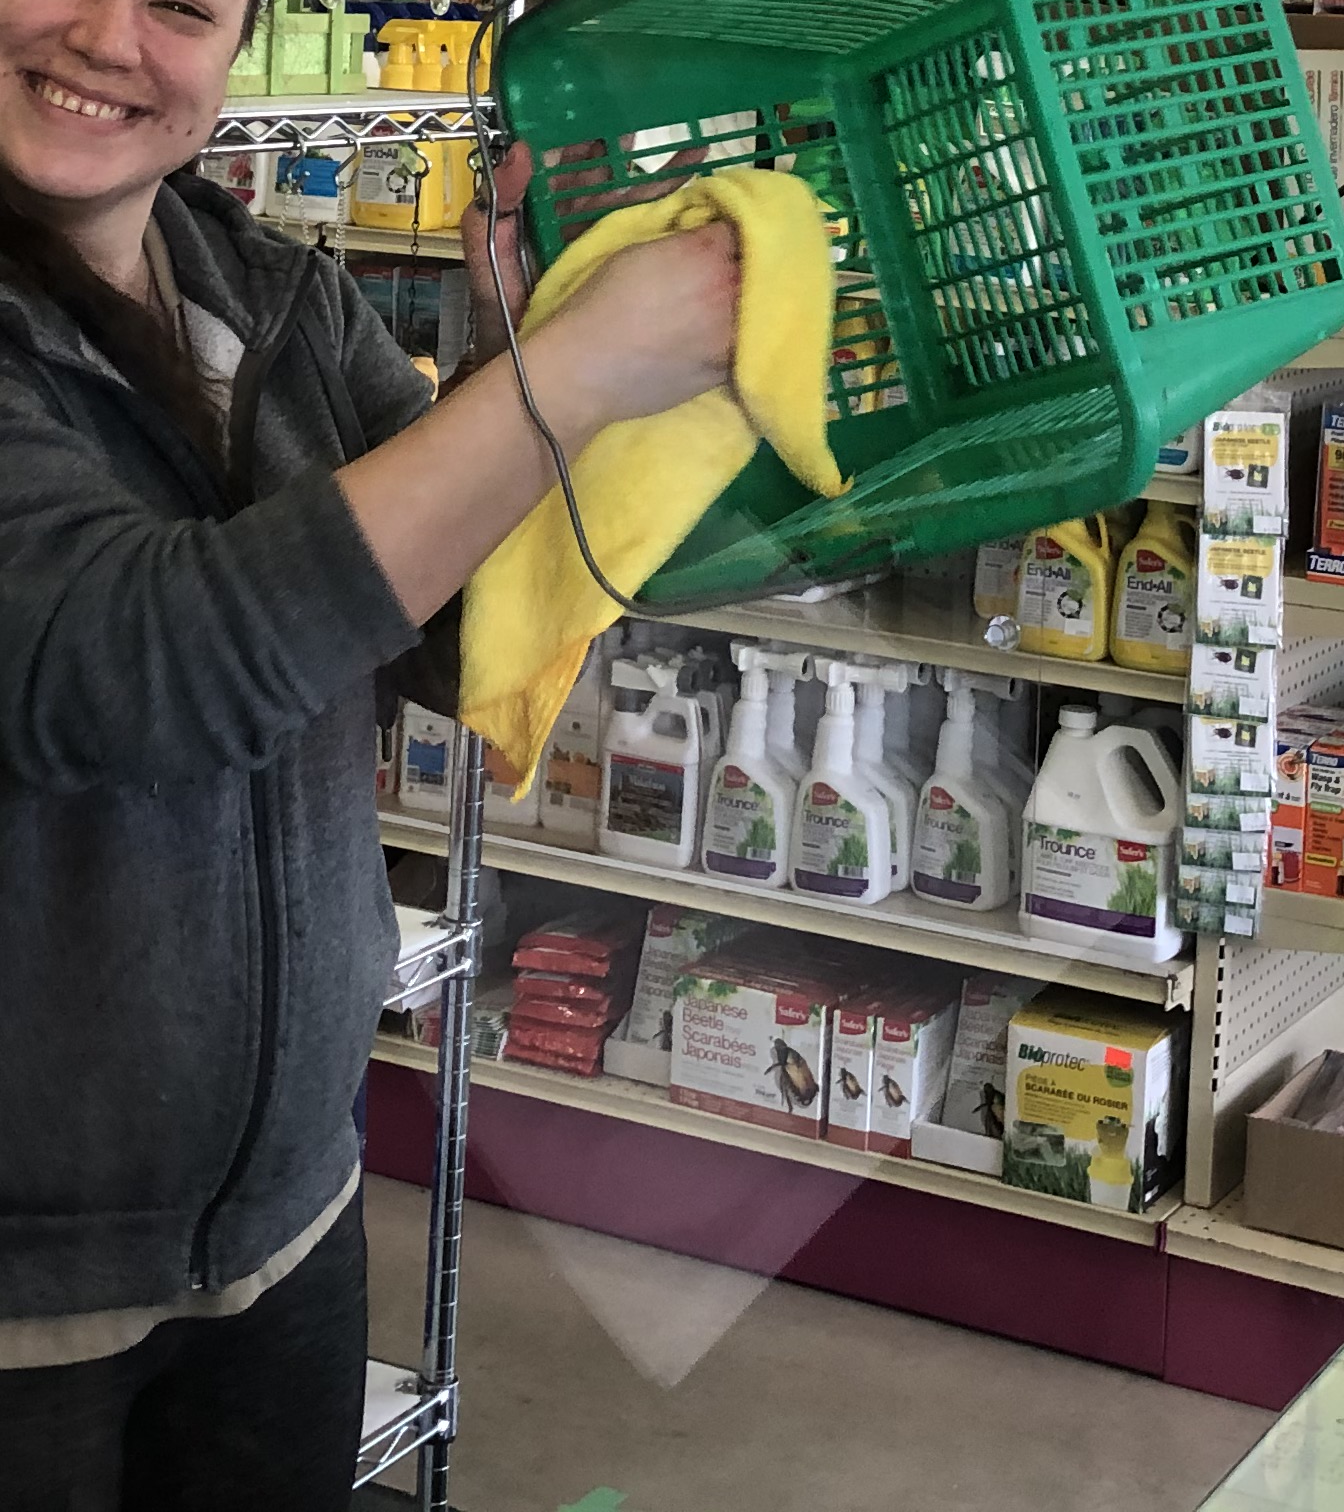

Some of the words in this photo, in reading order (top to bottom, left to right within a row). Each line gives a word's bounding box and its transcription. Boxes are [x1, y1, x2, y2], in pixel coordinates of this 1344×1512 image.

[715, 792, 758, 812] Trounce
[804, 809, 851, 829] Trounce
[1038, 834, 1096, 860] Trounce
[683, 994, 748, 1020] Japanese
[778, 1005, 806, 1021] Safer's
[683, 1008, 724, 1032] Beetle
[682, 1025, 756, 1056] Scarabées
[681, 1041, 742, 1069] Japonais
[1018, 1042, 1086, 1072] Bioprotec
[1077, 1092, 1091, 1104] DU
[1093, 1096, 1129, 1111] ROSIER
